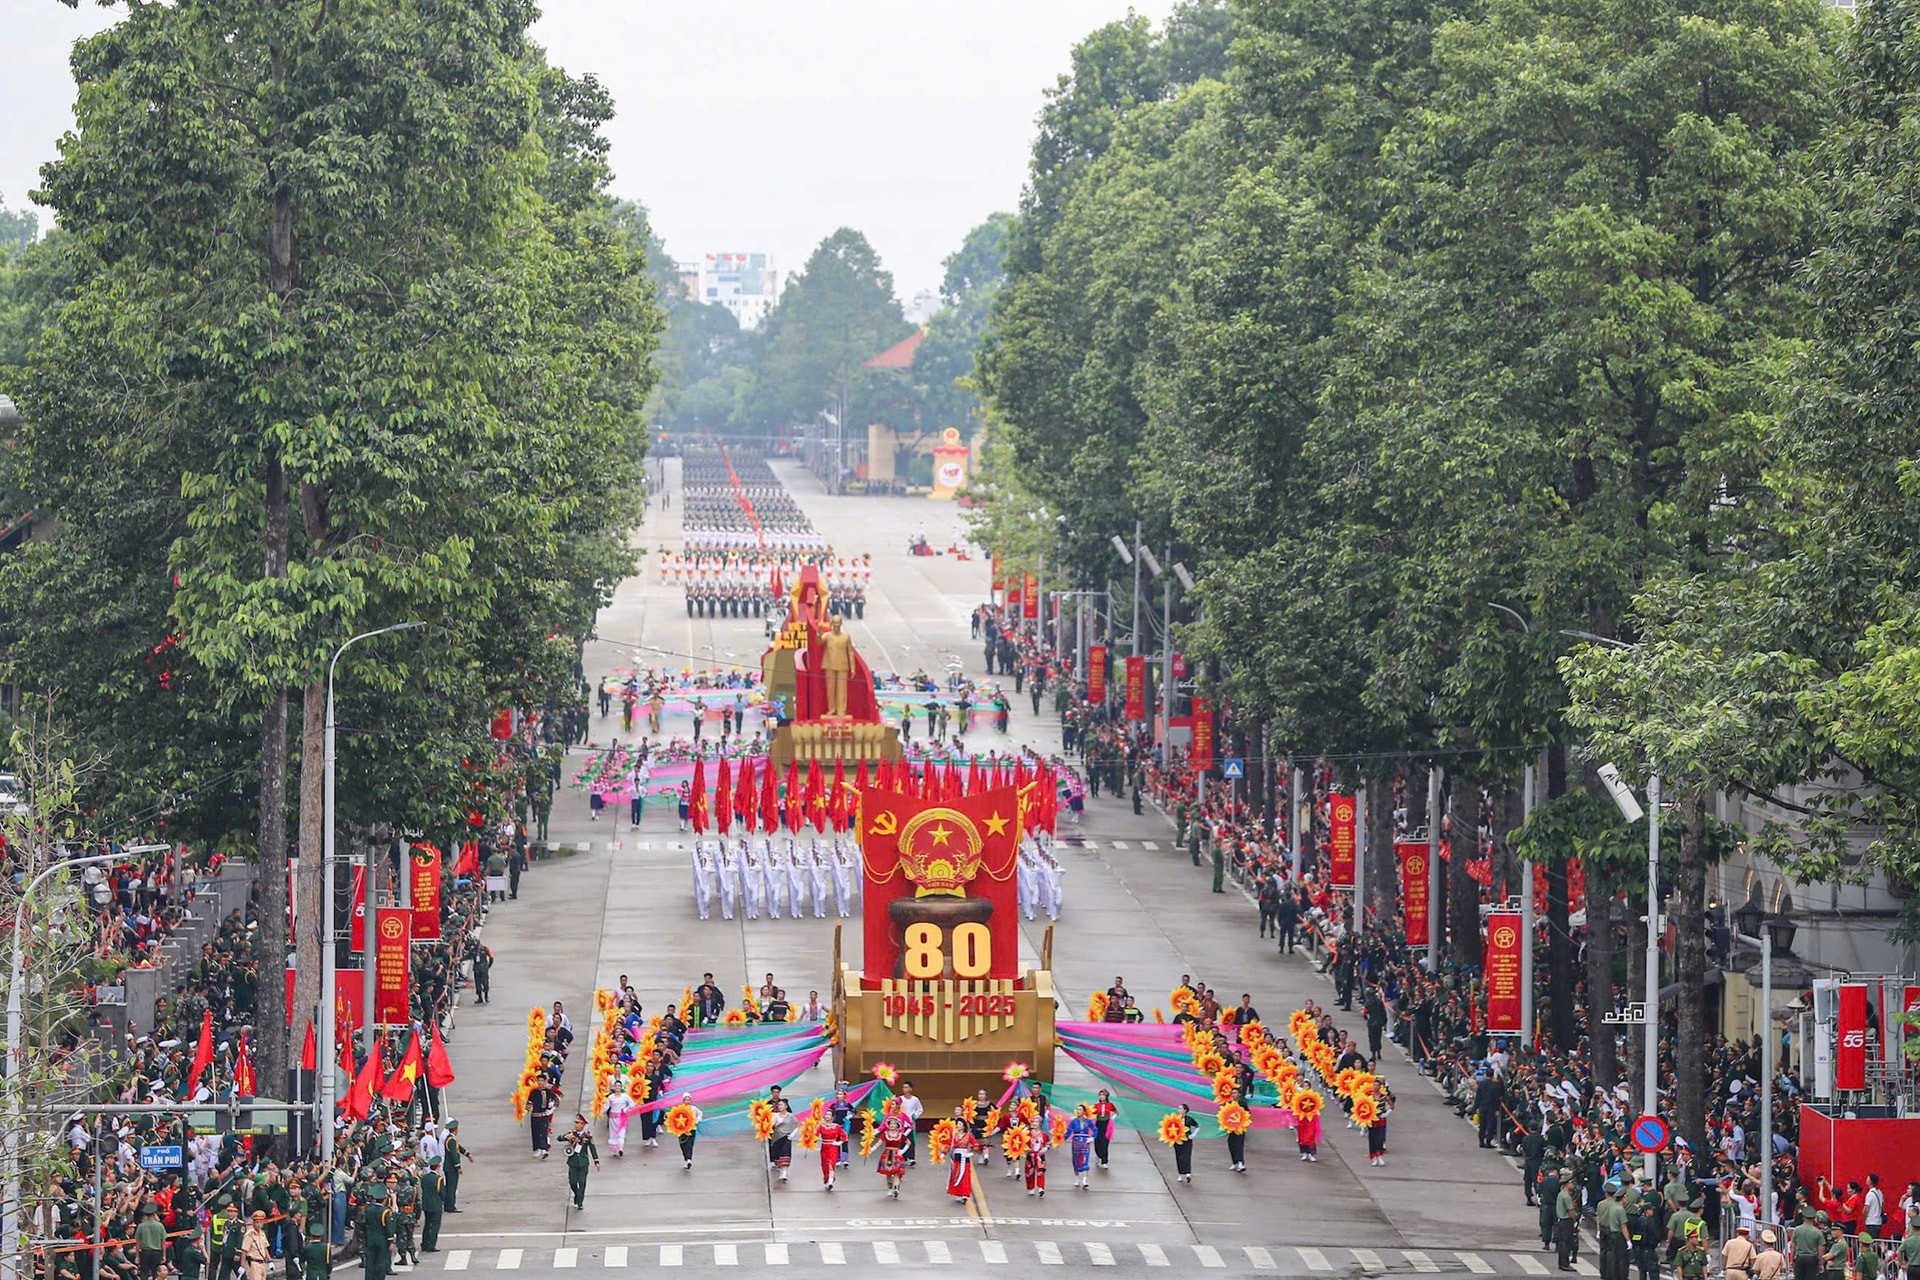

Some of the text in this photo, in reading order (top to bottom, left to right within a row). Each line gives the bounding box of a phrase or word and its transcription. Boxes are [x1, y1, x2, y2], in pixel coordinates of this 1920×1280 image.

[904, 922, 992, 978] 80
[883, 995, 935, 1016] 1945
[960, 995, 1016, 1016] 2025
[1843, 1034, 1864, 1048] 5G
